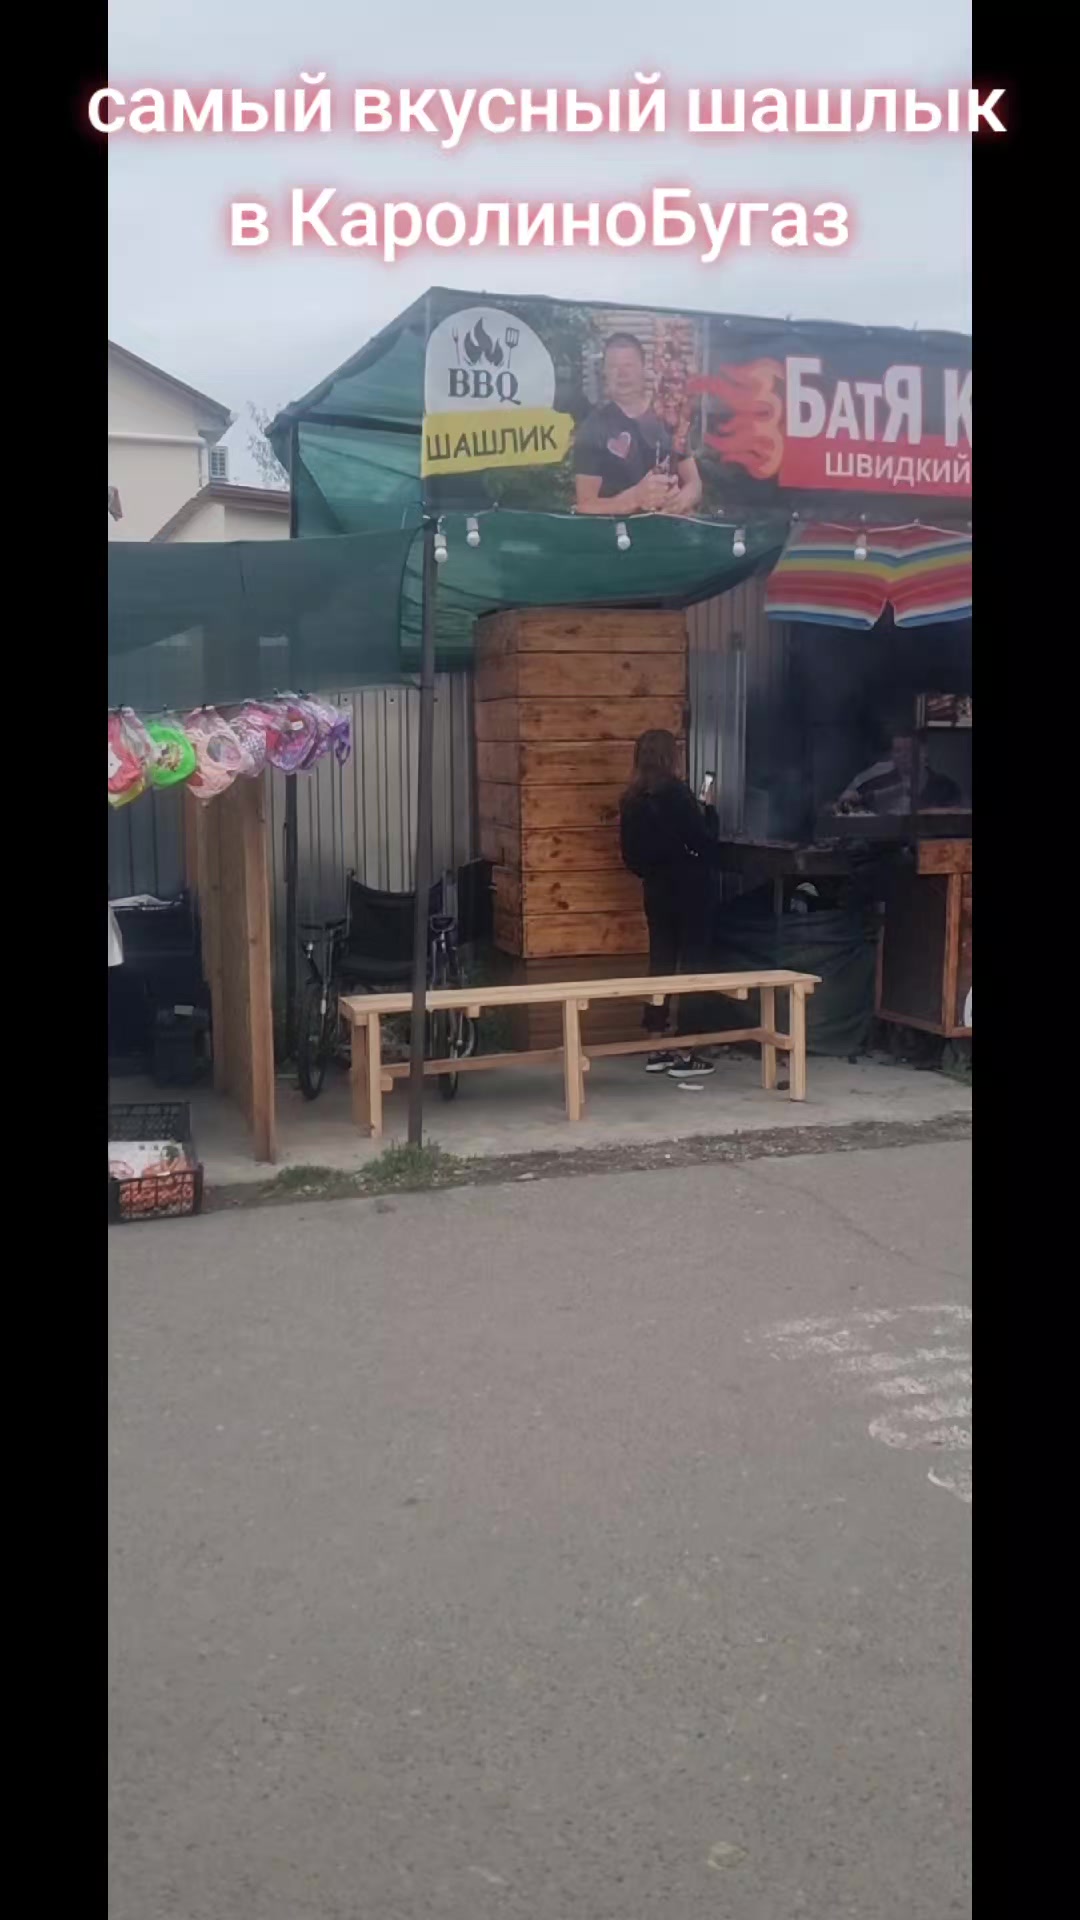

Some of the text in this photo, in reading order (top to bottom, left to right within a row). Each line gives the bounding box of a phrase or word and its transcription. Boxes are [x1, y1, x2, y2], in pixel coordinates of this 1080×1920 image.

[448, 367, 522, 406] BBQ
[426, 424, 558, 462] ШАШЛИК
[825, 451, 971, 488] ШВИДКИЙ
